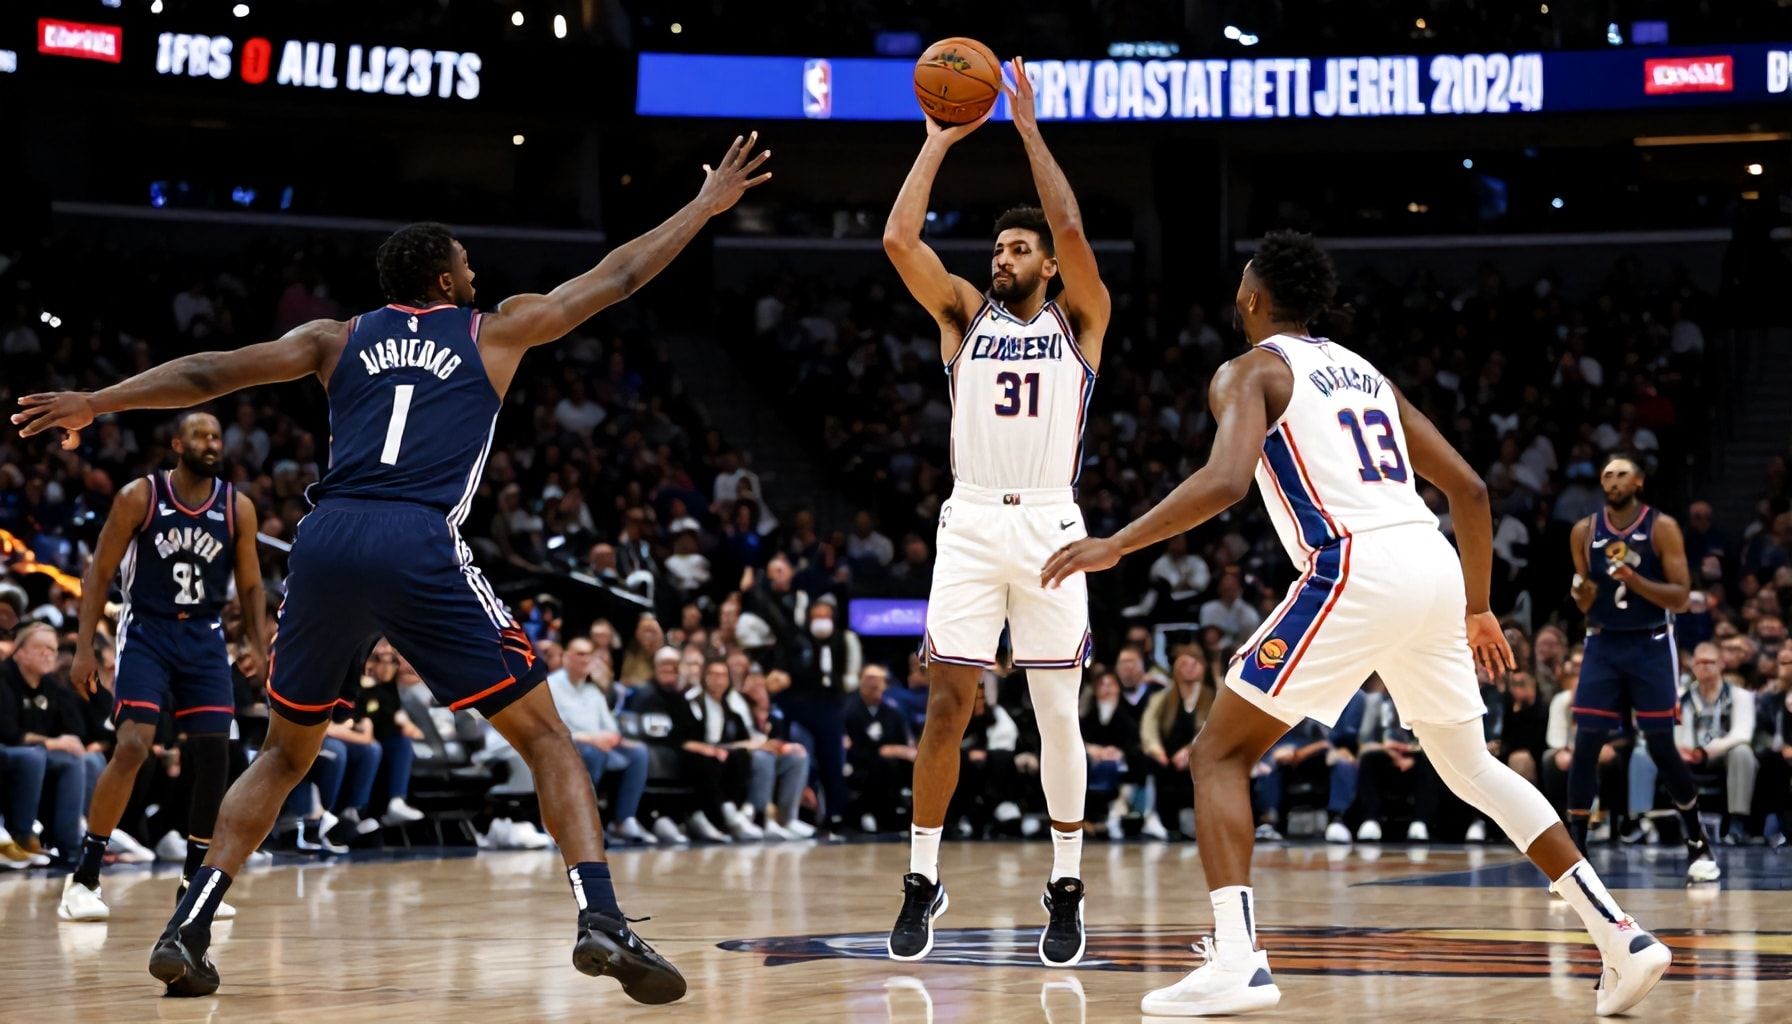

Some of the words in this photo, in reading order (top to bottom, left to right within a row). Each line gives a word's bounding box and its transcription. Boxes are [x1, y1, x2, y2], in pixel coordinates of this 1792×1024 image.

[278, 41, 337, 88] ALL
[1094, 60, 1228, 118] CASTAT
[995, 372, 1040, 417] 31
[381, 385, 415, 465] 1
[1338, 408, 1407, 483] 13
